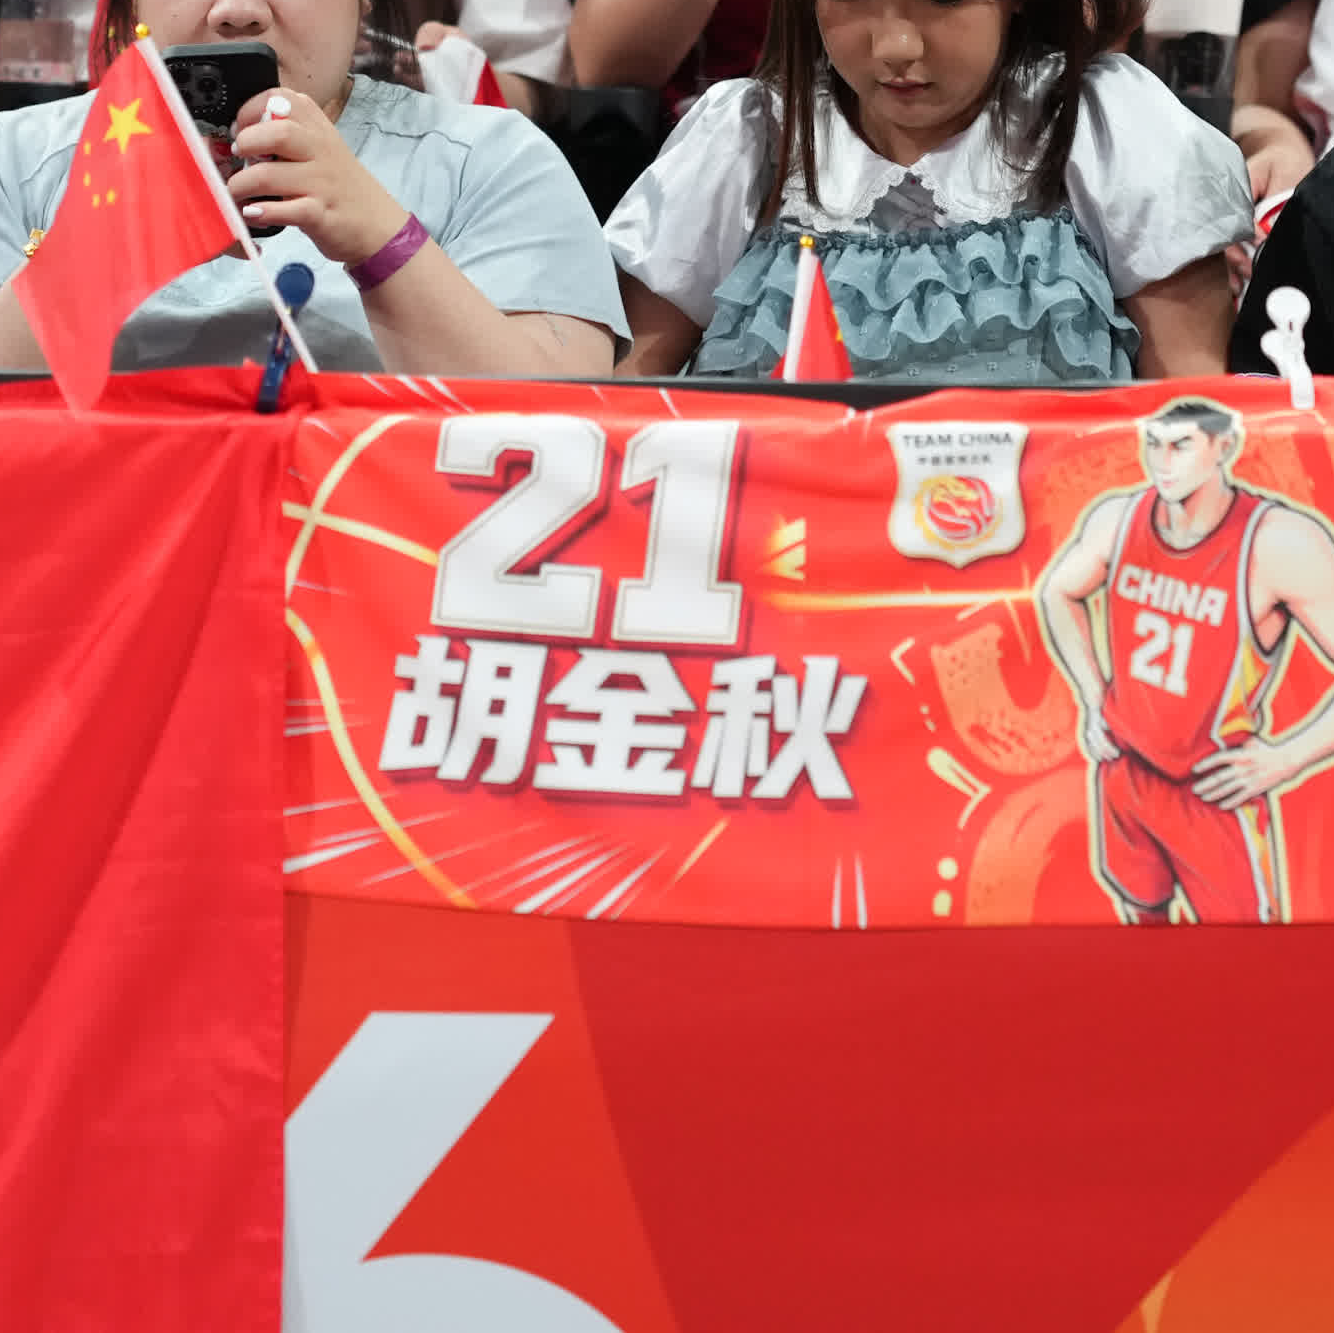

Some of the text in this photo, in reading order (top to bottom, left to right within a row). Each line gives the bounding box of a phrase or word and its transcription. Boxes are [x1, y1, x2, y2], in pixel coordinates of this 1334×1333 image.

[430, 414, 743, 645] 21
[1117, 563, 1229, 628] CHINA
[1130, 610, 1195, 699] 21
[378, 634, 868, 800] 胡金秋
